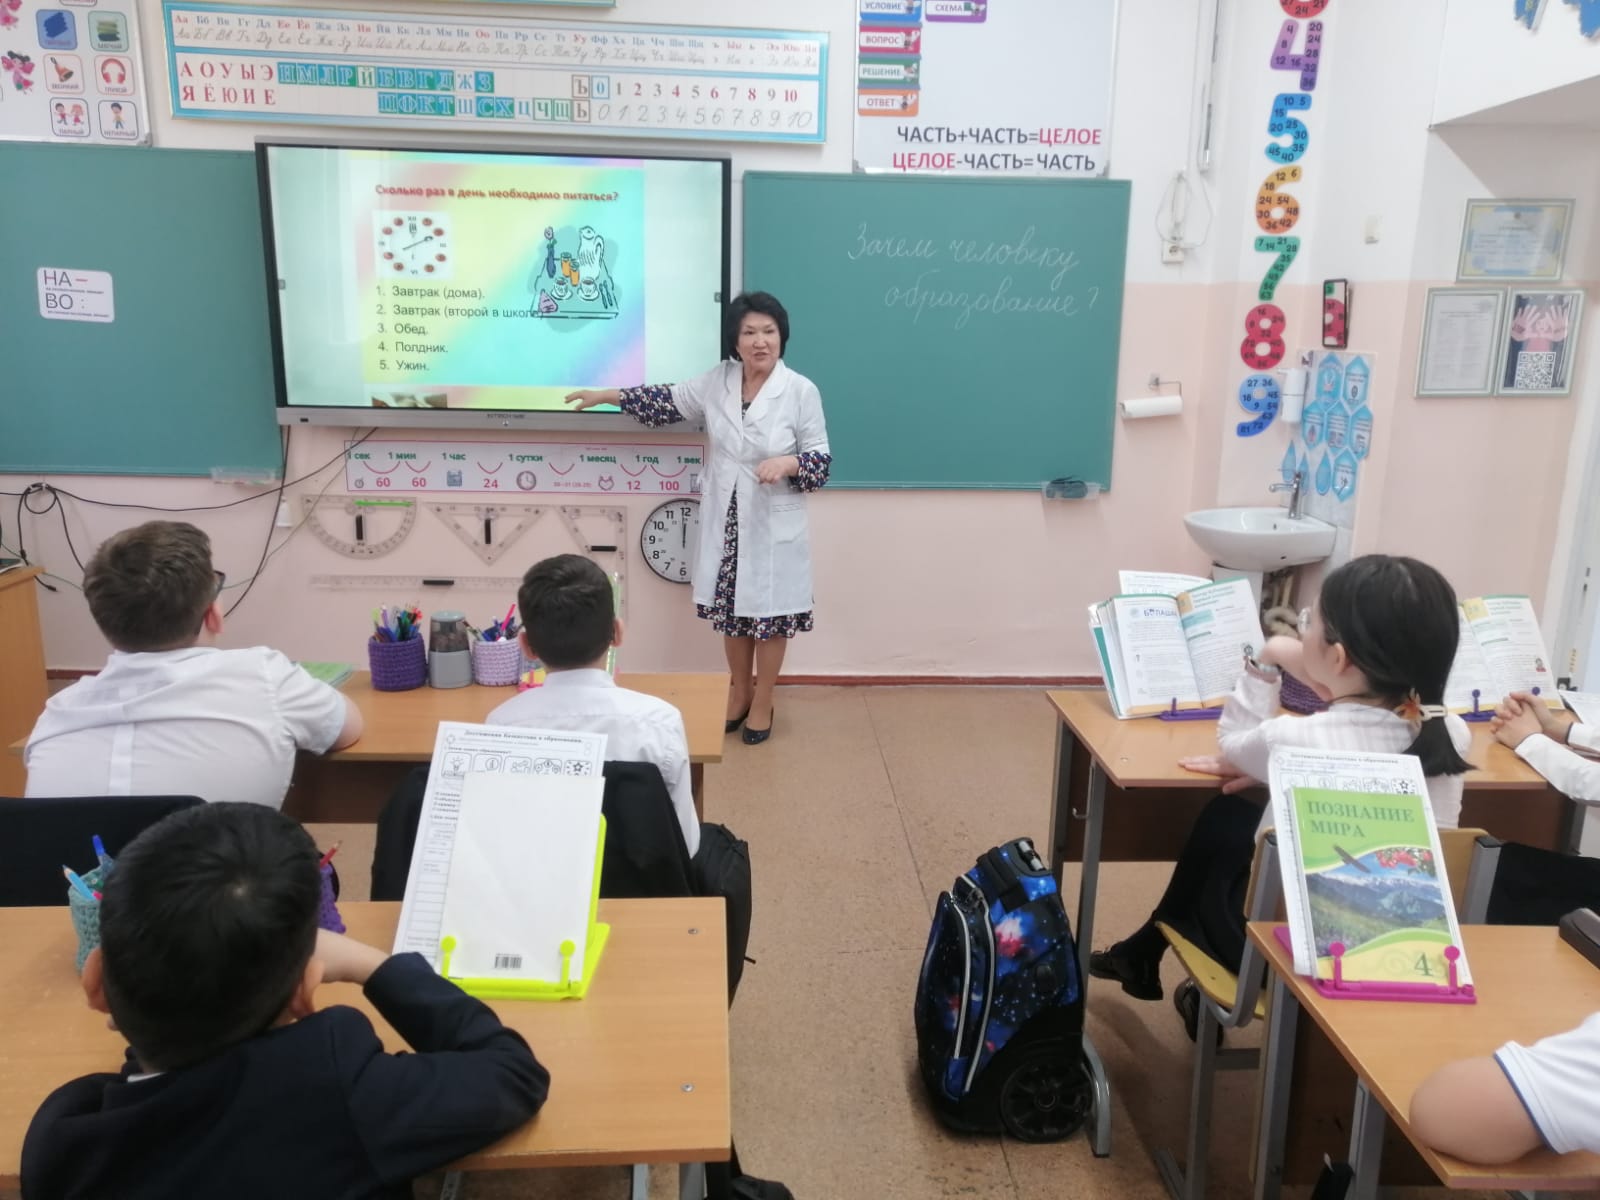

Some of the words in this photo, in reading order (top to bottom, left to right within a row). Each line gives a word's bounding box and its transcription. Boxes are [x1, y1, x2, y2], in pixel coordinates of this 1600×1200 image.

[935, 4, 962, 12] СХЕМА
[1287, 25, 1294, 34] 4
[1309, 22, 1322, 31] 20
[866, 36, 900, 44] ВОПРОС
[1307, 35, 1320, 43] 24
[1270, 19, 1323, 91] 4
[1305, 49, 1319, 58] 28
[1275, 56, 1286, 65] 12
[180, 61, 193, 77] А
[200, 62, 215, 78] О
[220, 62, 232, 79] У
[241, 64, 255, 80] Ы
[260, 65, 274, 81] Э
[457, 74, 473, 90] Ж
[576, 79, 588, 94] Ъ
[183, 86, 195, 101] Я
[204, 83, 216, 102] Ё
[222, 87, 238, 104] Ю
[243, 89, 255, 104] И
[264, 90, 276, 105] Е
[596, 84, 604, 95] 0
[616, 83, 621, 95] 1
[634, 84, 642, 96] 2
[653, 83, 662, 97] 3
[672, 85, 680, 97] 4
[691, 85, 700, 98] 5
[710, 86, 719, 99] 6
[730, 87, 737, 100] 7
[748, 88, 756, 101] 8
[768, 89, 776, 101] 9
[784, 89, 797, 102] 10
[867, 98, 895, 107] ОТВЕТ
[1284, 96, 1295, 106] 10
[1300, 97, 1306, 106] 5
[519, 101, 530, 117] Ц
[537, 102, 549, 118] Ч
[577, 103, 587, 118] Ь
[1275, 109, 1285, 117] 15
[1264, 93, 1312, 164] 5
[1270, 123, 1283, 132] 20
[1286, 119, 1298, 129] 25
[1294, 130, 1307, 139] 30
[1269, 147, 1281, 157] 45
[1292, 144, 1305, 152] 35
[1281, 152, 1294, 162] 40
[1276, 172, 1286, 181] 12
[1291, 169, 1297, 178] 6
[375, 185, 423, 196] Сколько
[426, 188, 445, 198] раз
[458, 190, 485, 198] день
[488, 188, 560, 201] необходимо
[563, 191, 618, 201] питаться?
[1255, 165, 1302, 234] 6
[1259, 196, 1272, 205] 24
[1276, 196, 1290, 205] 54
[1257, 210, 1270, 219] 30
[1286, 207, 1299, 216] 48
[1280, 219, 1292, 228] 42
[1259, 238, 1264, 247] 7
[848, 221, 935, 261] Зачем
[949, 224, 1080, 292] человеку
[1254, 236, 1301, 301] 7
[44, 269, 72, 287] НА
[376, 286, 386, 296] 1.
[392, 286, 440, 299] Завтрак
[443, 287, 485, 300] (дома).
[46, 293, 73, 310] ВО
[376, 304, 386, 315] 2.
[393, 305, 440, 318] Завтрак
[444, 306, 488, 318] (второй
[377, 323, 387, 333] 3.
[394, 323, 428, 335] Обед.
[1240, 303, 1286, 371] 8
[378, 342, 388, 351] 4.
[395, 342, 448, 353] Полдник.
[379, 360, 389, 370] 5.
[396, 360, 430, 371] Ужин.
[1247, 379, 1258, 387] 27
[1236, 374, 1280, 437] 9
[1254, 402, 1259, 410] 9
[516, 455, 543, 463] сутки
[580, 454, 584, 462] 1
[587, 455, 617, 464] месяц
[642, 456, 659, 465] год
[376, 478, 390, 487] 60
[412, 478, 426, 487] 60
[484, 478, 498, 488] 24
[627, 481, 641, 490] 12
[659, 481, 679, 491] 100
[665, 510, 674, 519] 11
[680, 507, 691, 517] 12
[653, 521, 664, 530] 10
[649, 535, 656, 544] 9
[652, 550, 660, 559] 8
[664, 562, 671, 570] 7
[680, 567, 687, 576] 6
[1307, 800, 1415, 822] ПОЗНАНИЕ
[1310, 820, 1365, 837] МИРА
[1414, 953, 1433, 977] 4
